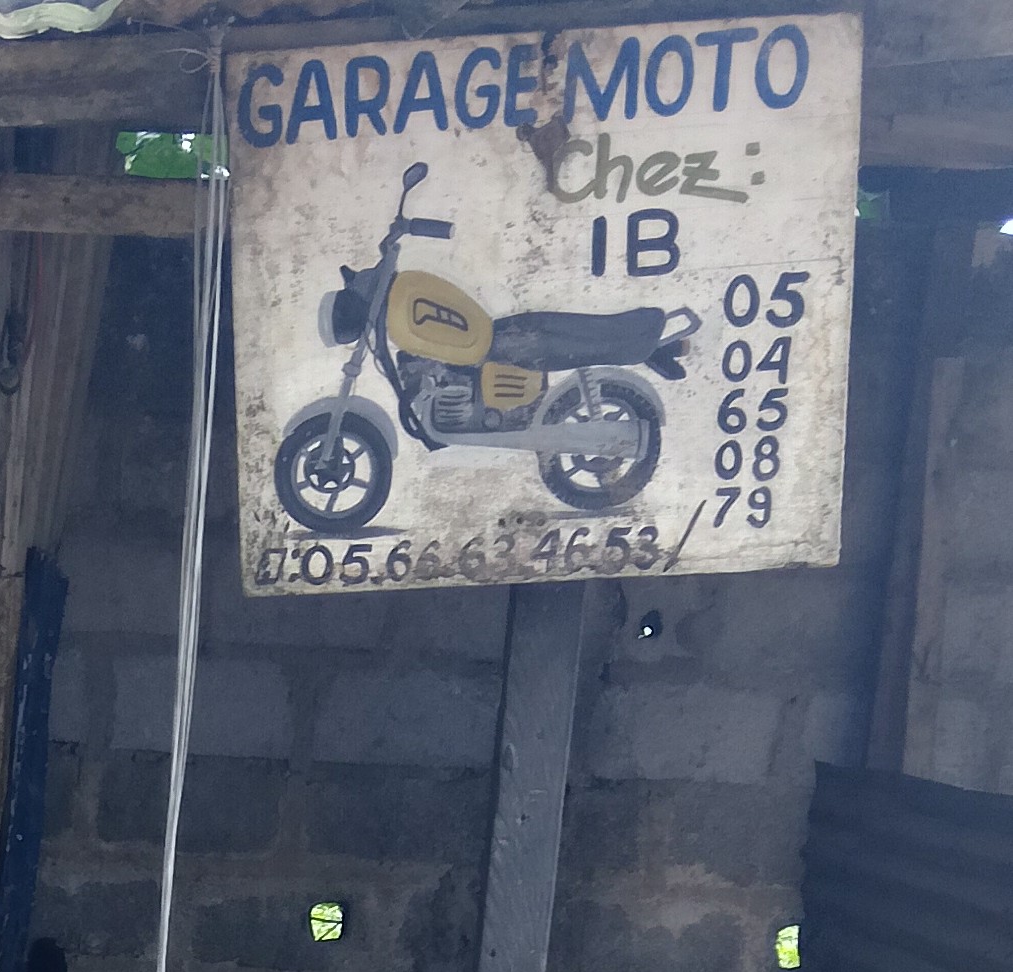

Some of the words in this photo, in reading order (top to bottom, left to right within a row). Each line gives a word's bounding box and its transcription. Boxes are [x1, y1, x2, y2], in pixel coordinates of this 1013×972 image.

[237, 43, 538, 148] GARAGE
[563, 24, 810, 123] MOTO
[723, 271, 812, 328] 05
[721, 336, 793, 384] 04
[717, 388, 789, 434] 65
[713, 435, 782, 483] 08
[713, 486, 773, 529] 79
